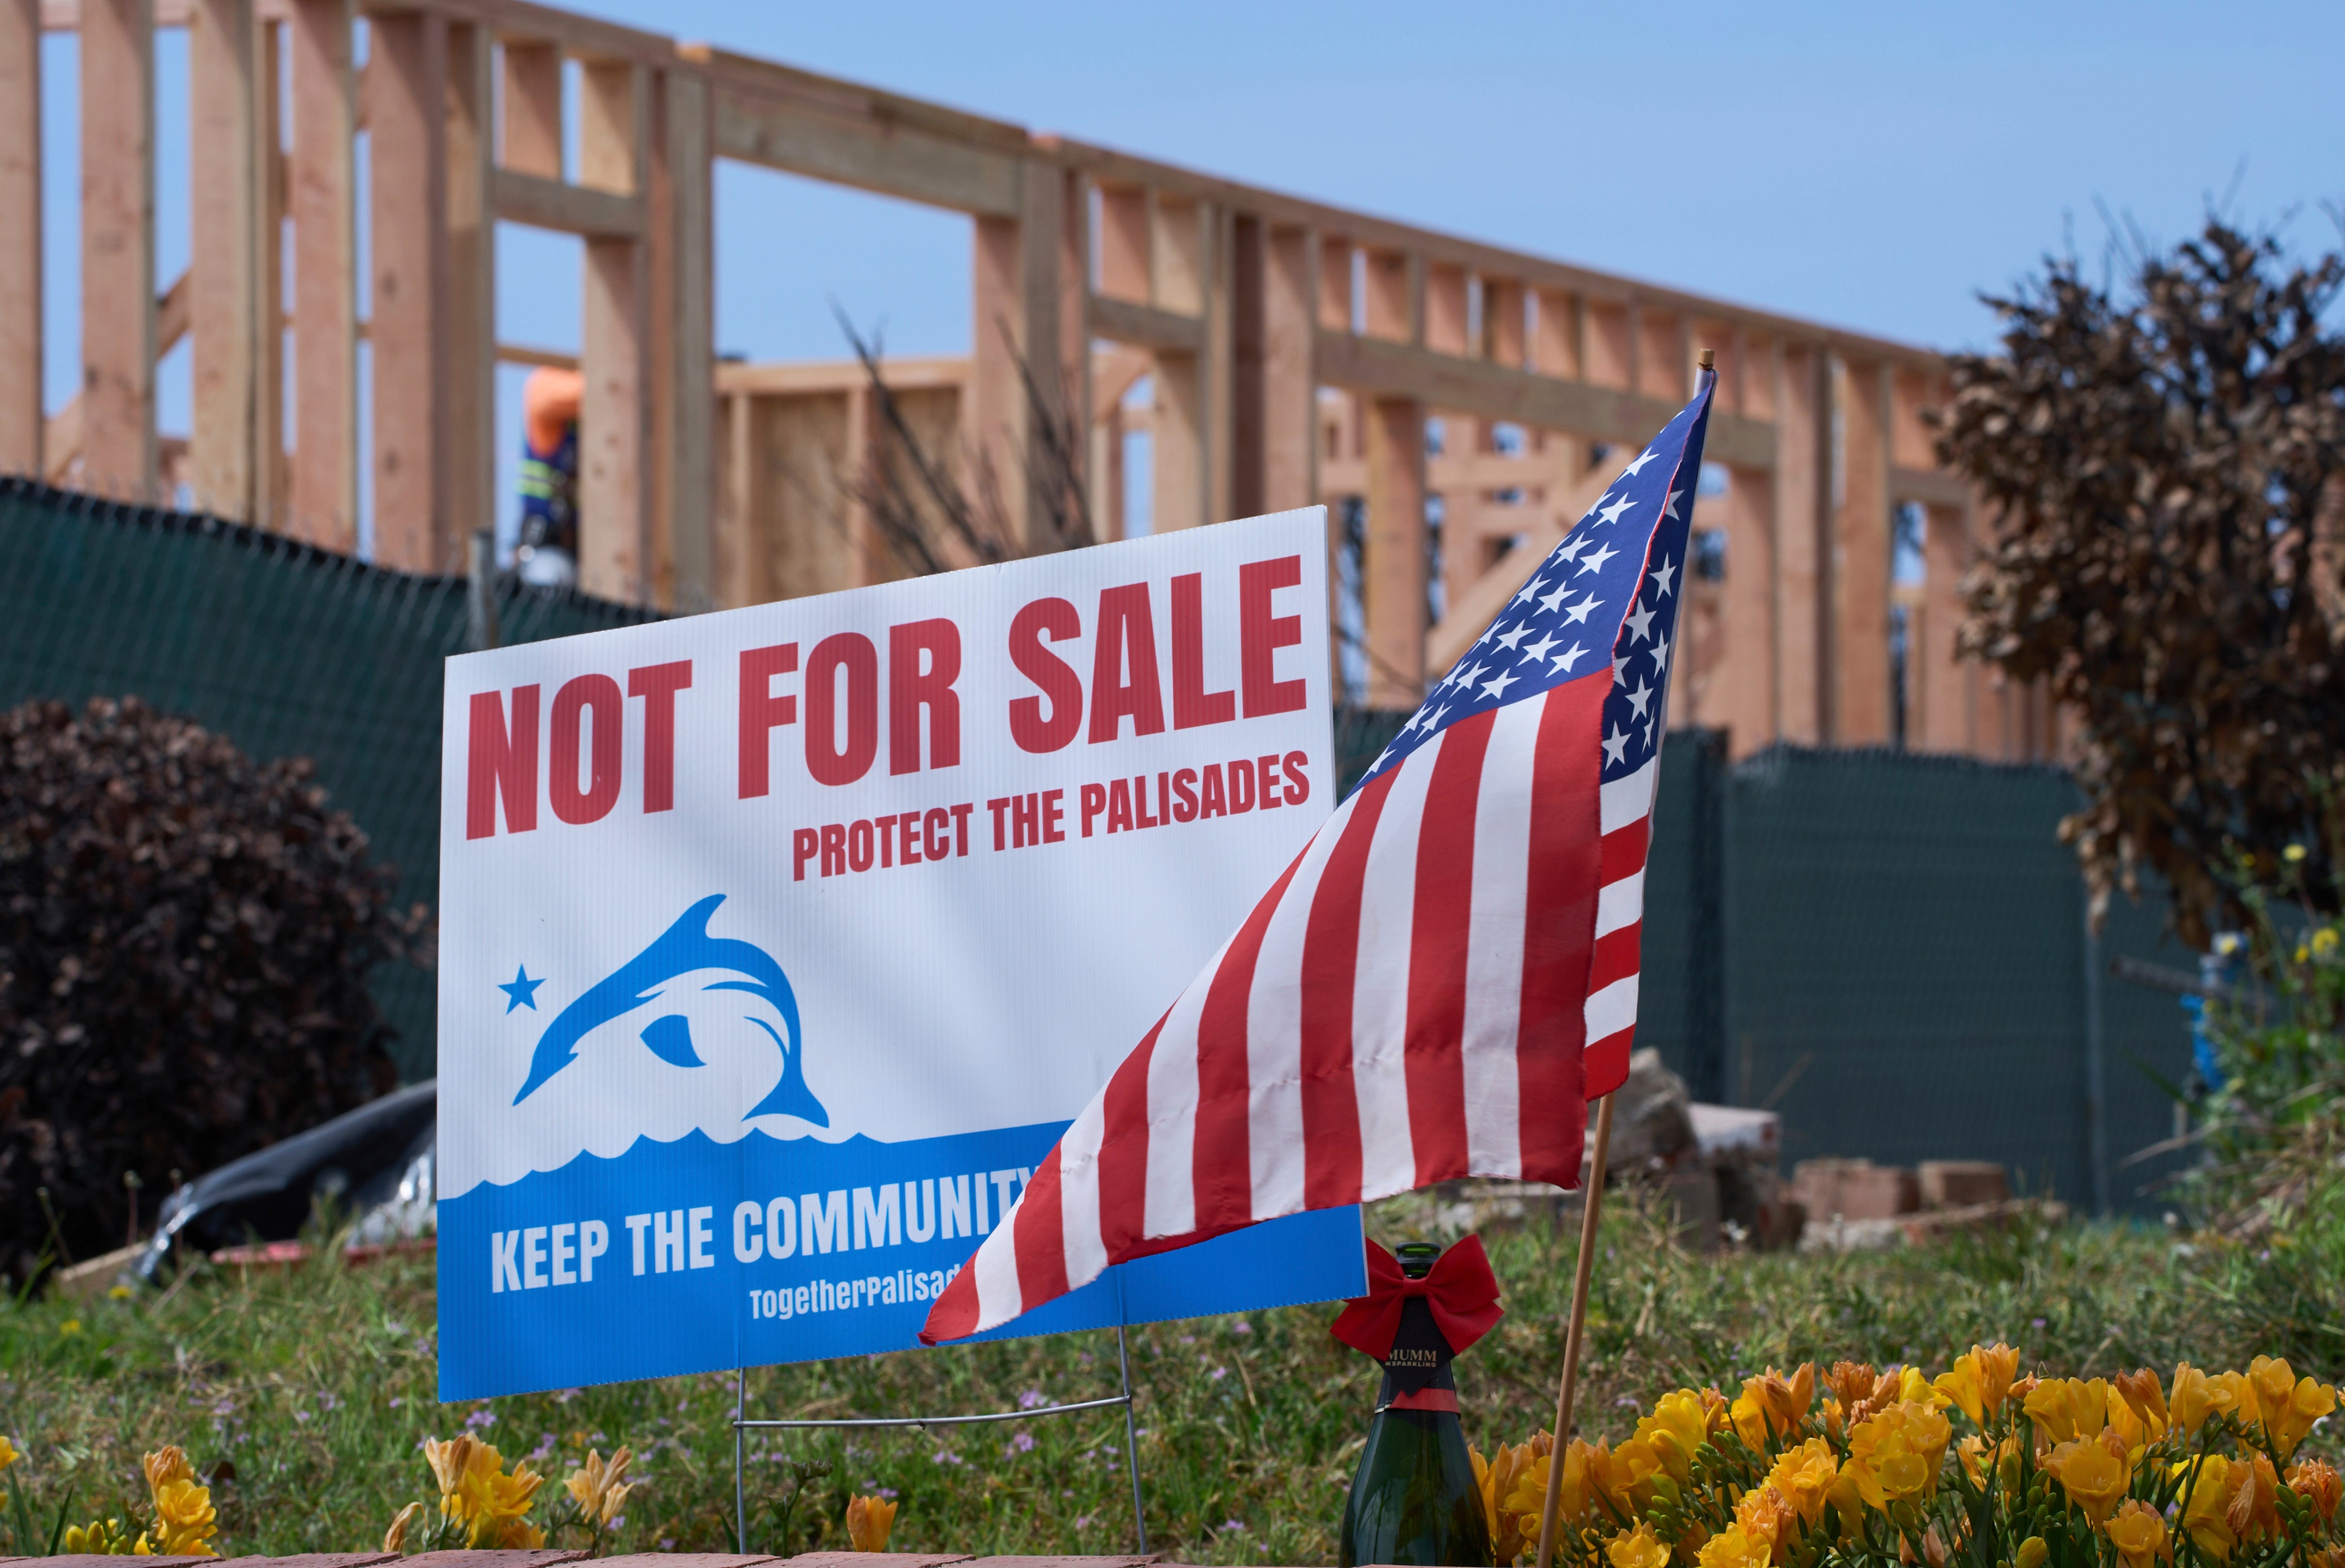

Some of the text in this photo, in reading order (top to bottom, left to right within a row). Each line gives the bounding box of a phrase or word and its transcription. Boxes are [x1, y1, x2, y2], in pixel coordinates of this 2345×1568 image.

[467, 555, 1307, 840] NOT FOR SALE
[793, 750, 1309, 881] PROTECT THE PALISADES
[492, 1220, 609, 1293] KEEP
[625, 1206, 714, 1276] THE
[1389, 1350, 1436, 1361] MUMM
